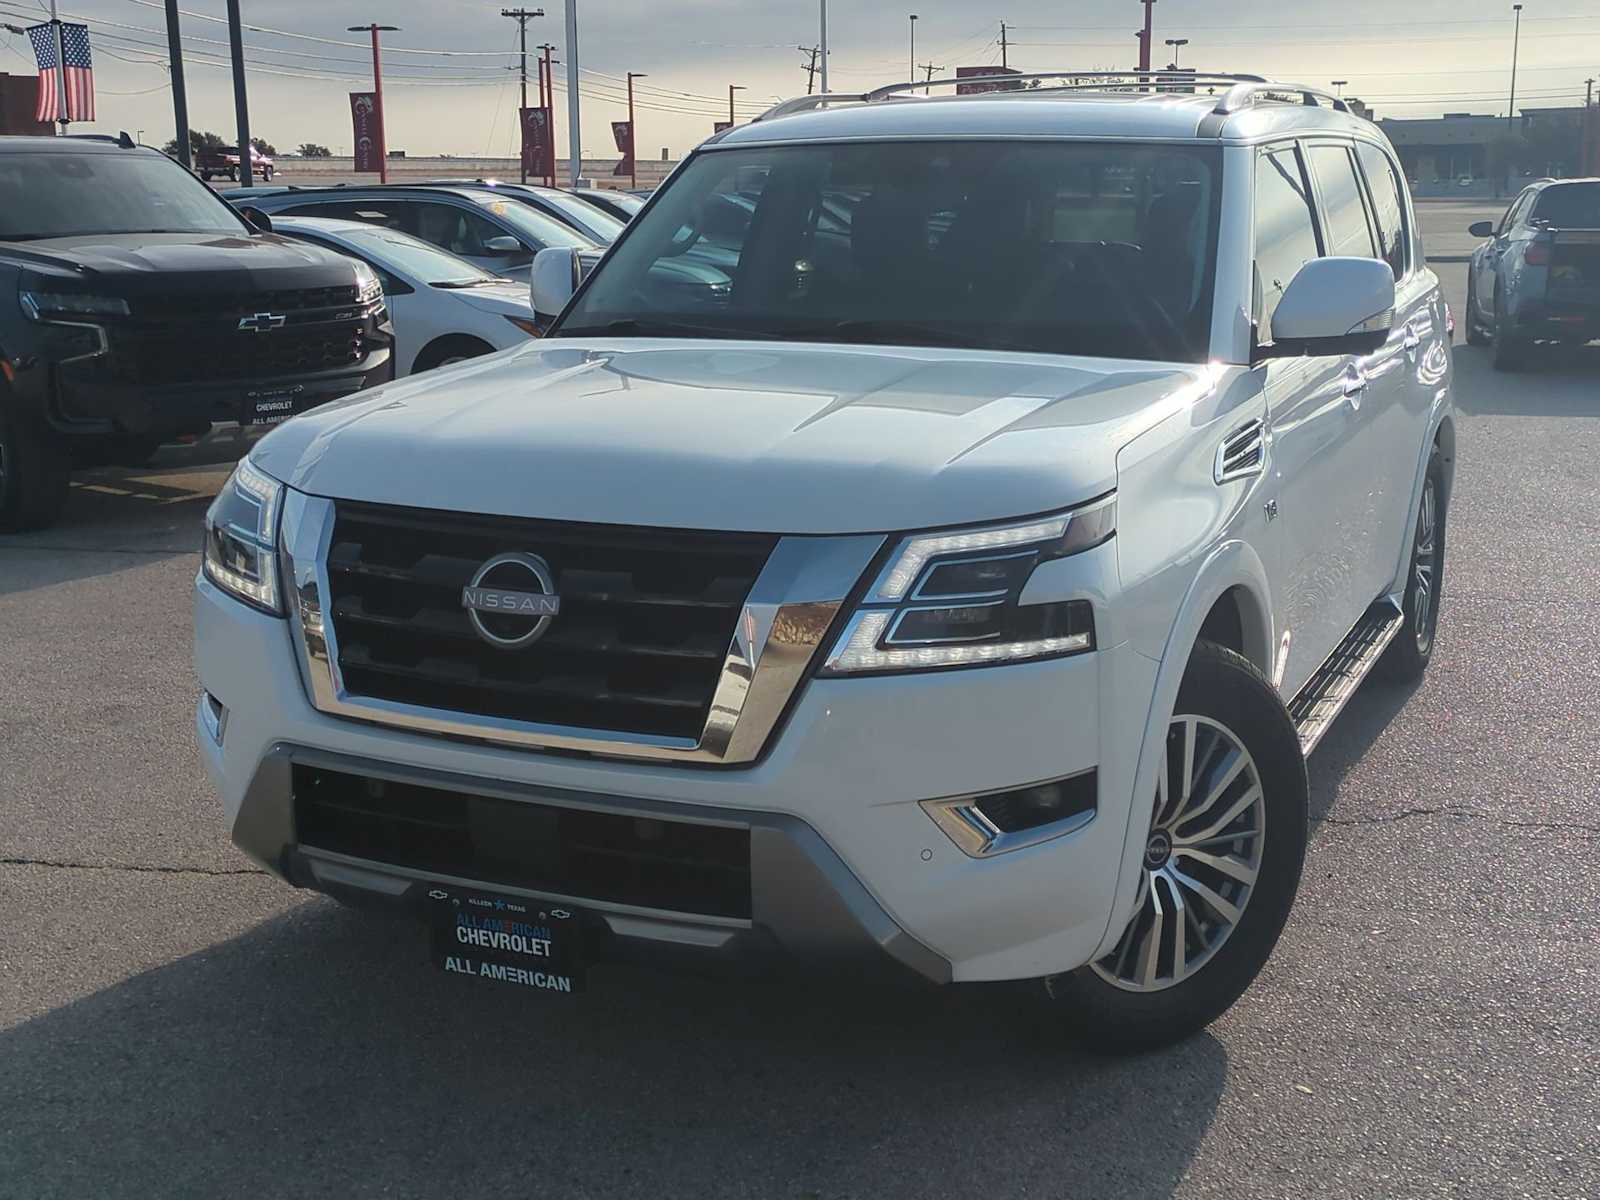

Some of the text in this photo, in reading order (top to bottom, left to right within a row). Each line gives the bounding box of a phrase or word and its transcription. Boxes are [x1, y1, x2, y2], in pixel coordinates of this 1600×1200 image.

[256, 400, 292, 412] CHEVROLET
[252, 417, 265, 425] ALL
[463, 591, 556, 612] NISSAN
[468, 898, 526, 913] KILLEEN TEXAS
[457, 912, 551, 938] ALL AMERICAN
[456, 926, 552, 957] CHEVROLET
[445, 956, 572, 993] ALL AMERICAN
